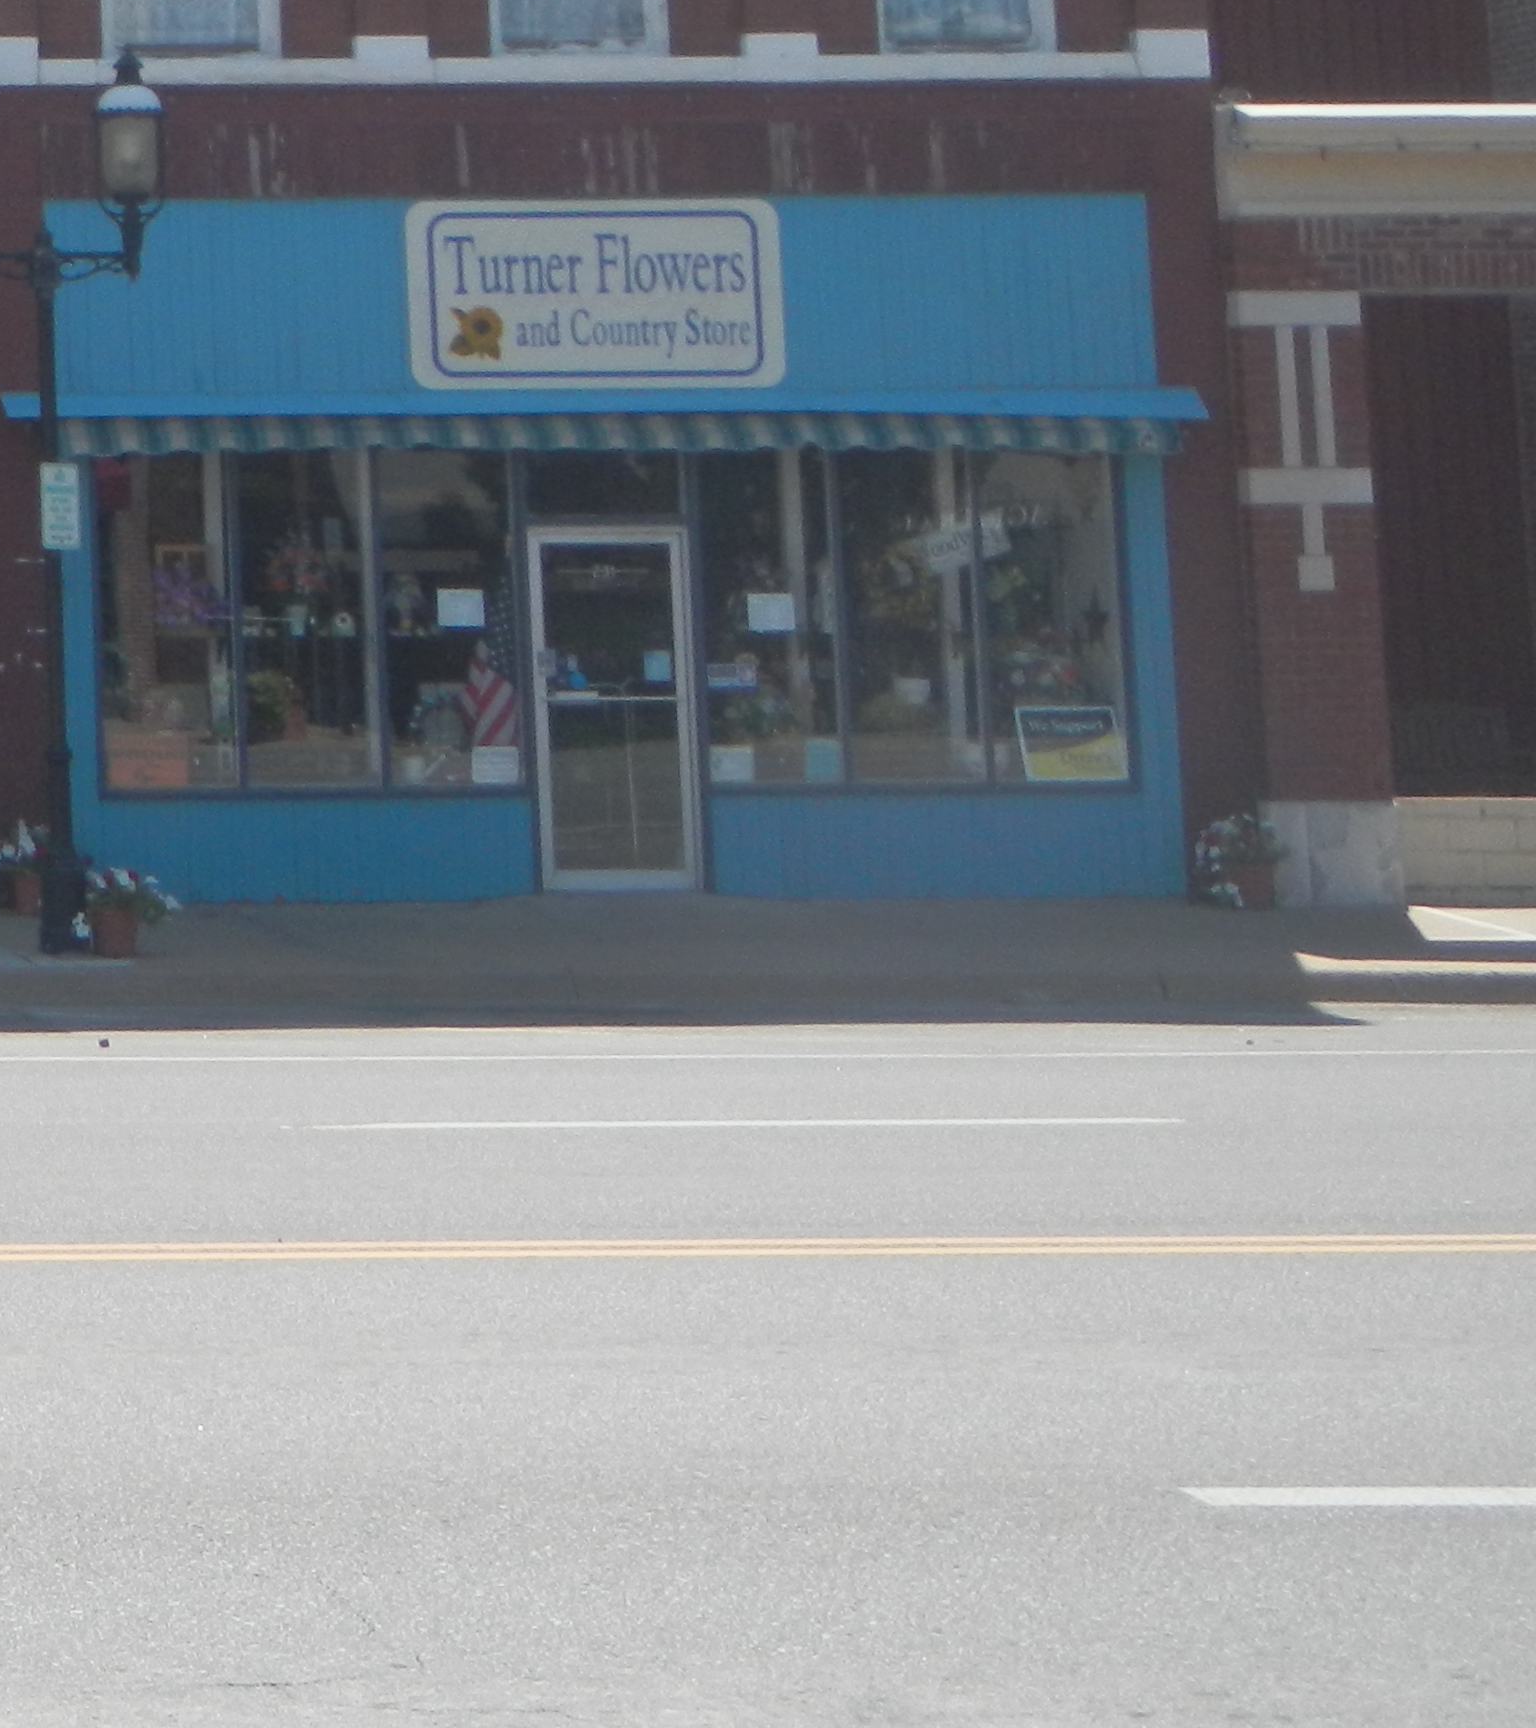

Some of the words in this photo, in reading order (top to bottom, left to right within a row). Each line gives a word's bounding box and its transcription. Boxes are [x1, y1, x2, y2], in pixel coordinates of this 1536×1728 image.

[443, 235, 582, 295] Turner
[593, 233, 747, 294] Flowers
[516, 309, 561, 347] and
[570, 308, 678, 359] Country
[685, 308, 751, 347] Store
